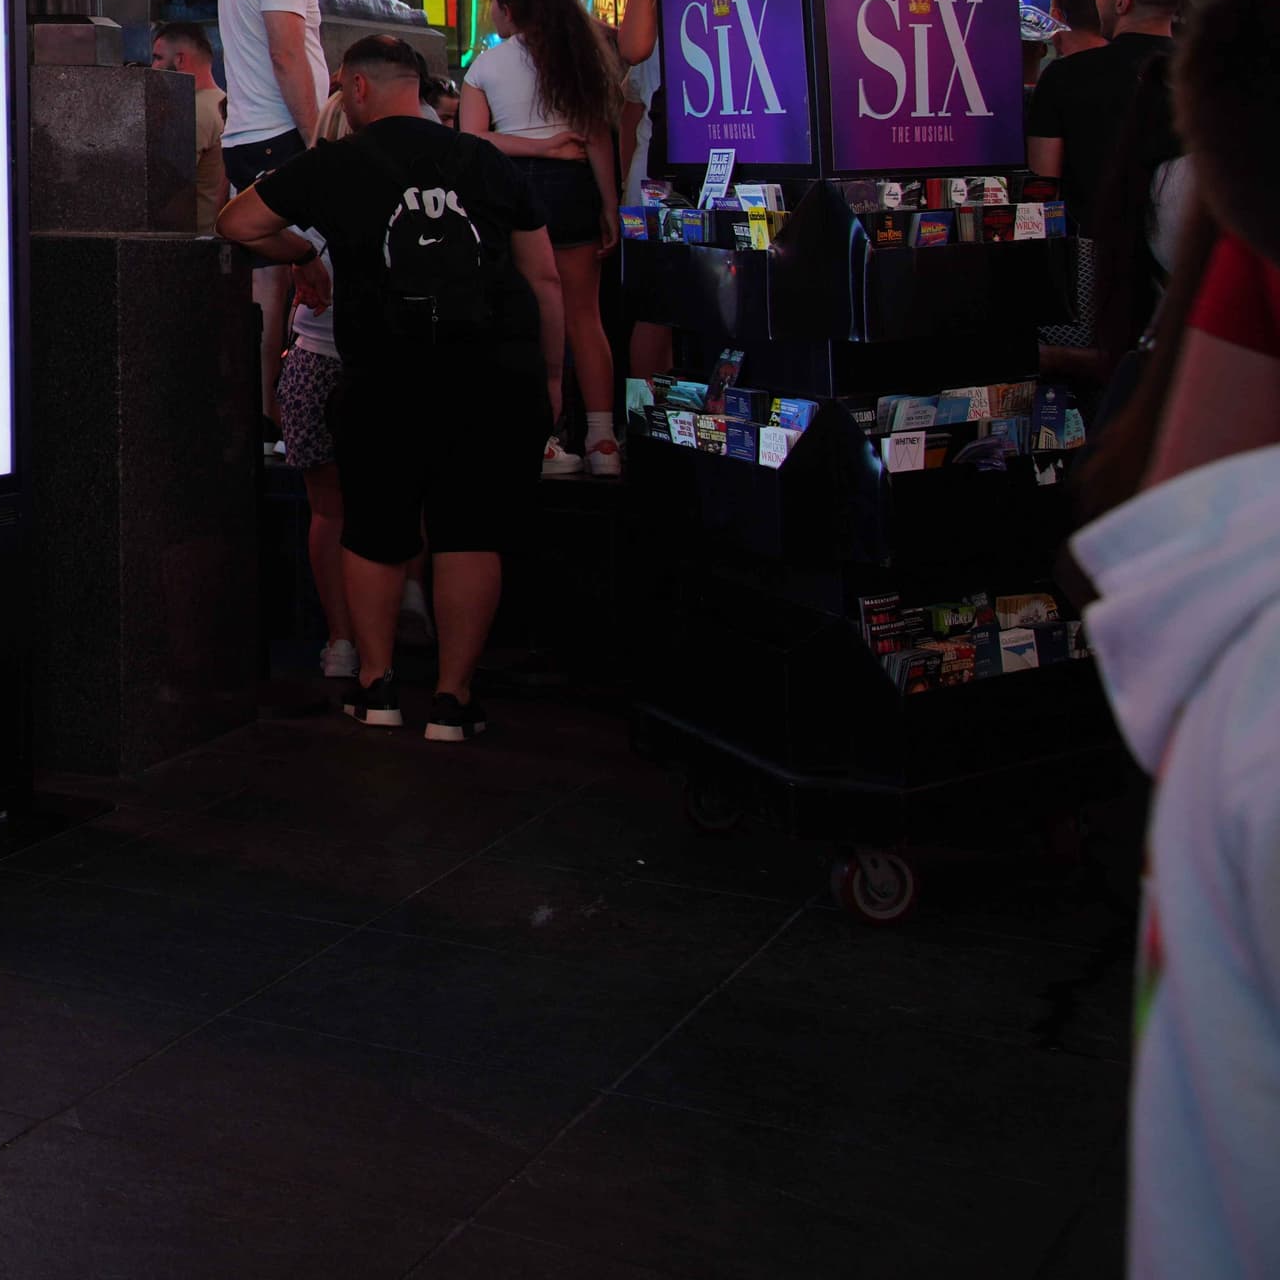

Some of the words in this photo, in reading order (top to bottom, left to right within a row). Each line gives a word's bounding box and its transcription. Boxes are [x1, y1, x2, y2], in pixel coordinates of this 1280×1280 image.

[708, 124, 722, 140] THE
[723, 123, 756, 140] MUSICAL
[892, 126, 911, 143] THE
[914, 125, 954, 143] MUSICAL
[895, 436, 920, 446] WHITNEY
